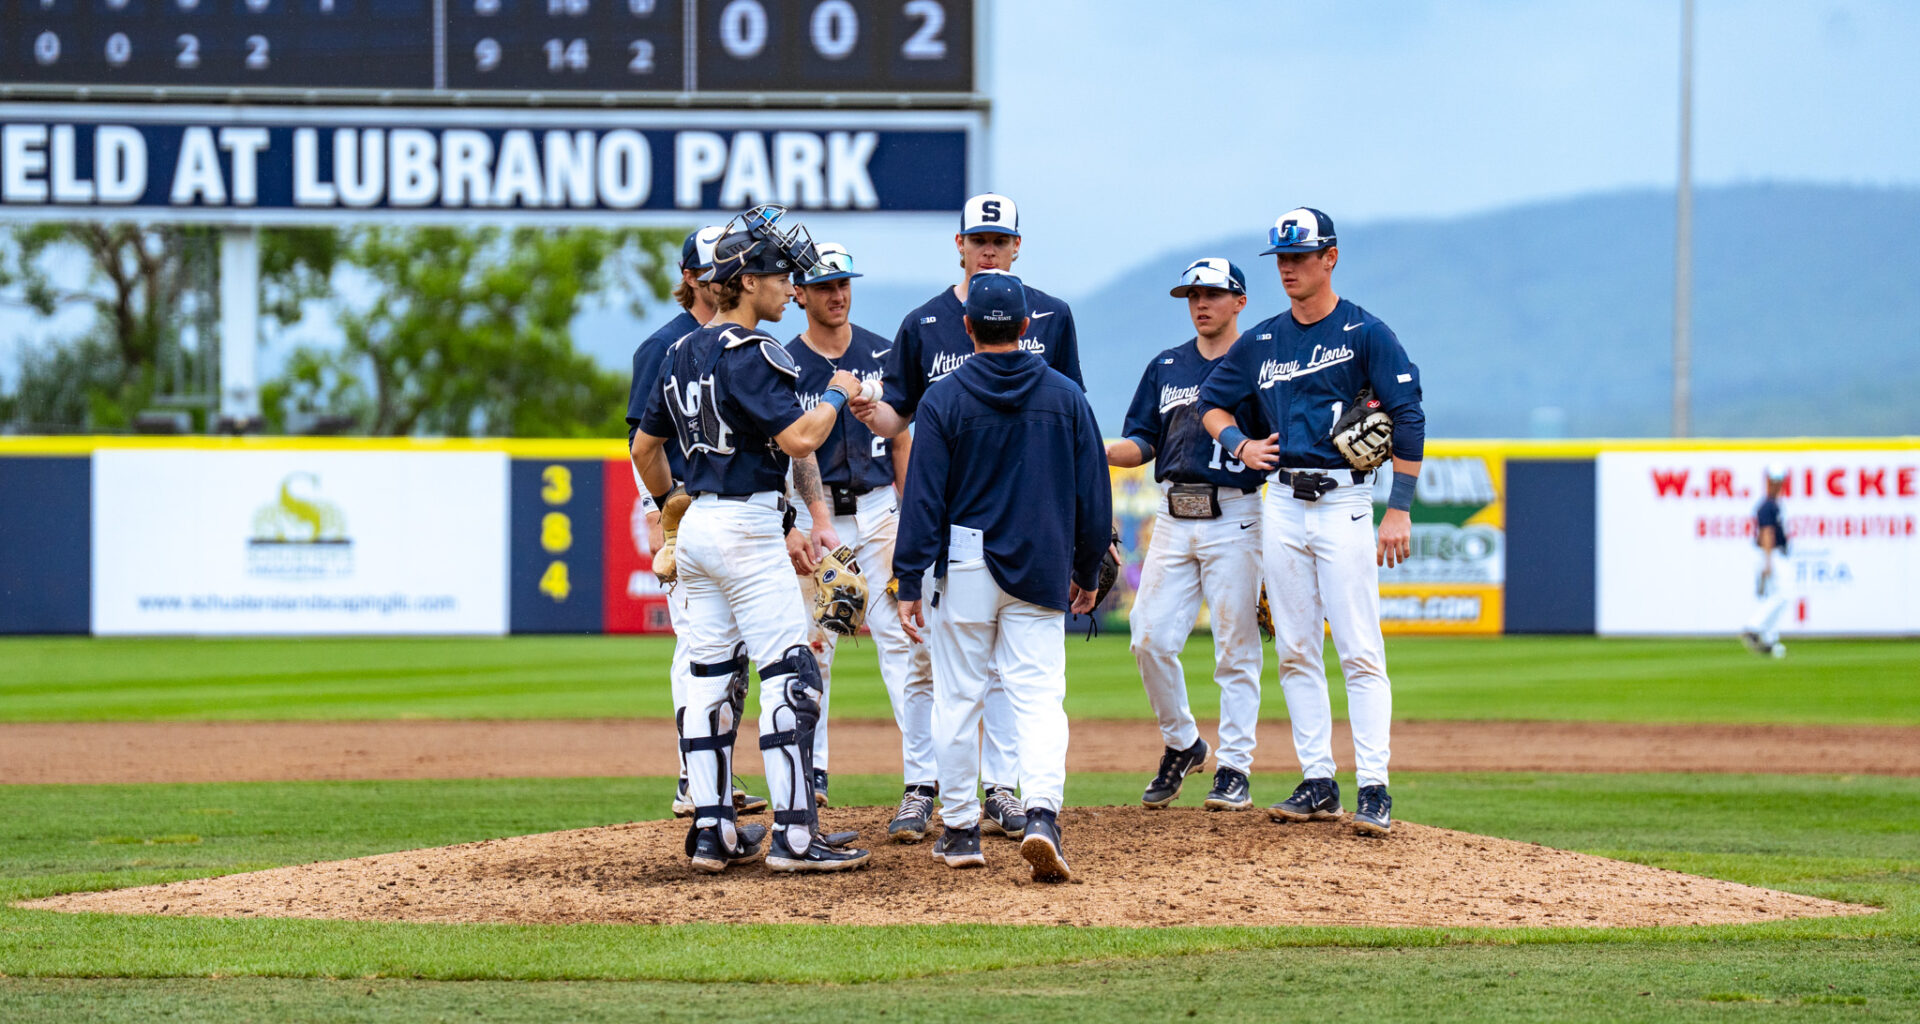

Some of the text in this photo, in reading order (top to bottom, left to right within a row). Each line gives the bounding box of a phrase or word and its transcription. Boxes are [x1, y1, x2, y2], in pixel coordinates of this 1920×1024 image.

[720, 0, 947, 60] 0 0 2
[34, 31, 270, 69] 0 0 2 2
[474, 37, 655, 73] 9 14 2
[2, 124, 880, 209] ELD AT LUBRANO PARK
[982, 201, 1000, 222] S
[1307, 344, 1354, 368] Lions
[1159, 383, 1200, 410] Nittany
[1651, 469, 1749, 497] W.R.
